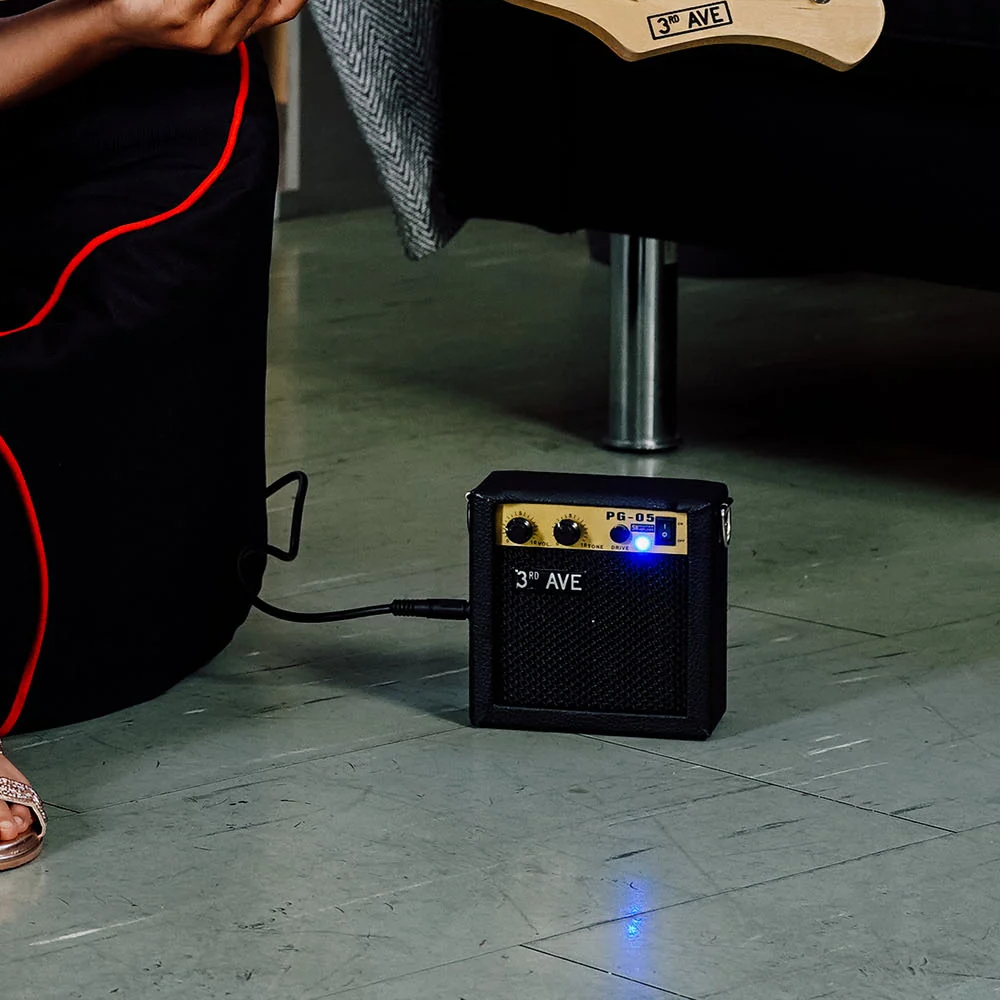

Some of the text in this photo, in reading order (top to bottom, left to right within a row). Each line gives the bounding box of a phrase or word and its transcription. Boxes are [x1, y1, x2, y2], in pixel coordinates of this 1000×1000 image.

[657, 6, 724, 34] 3RD AVE
[606, 511, 655, 523] PG-05
[516, 571, 582, 591] 3RD AVE
